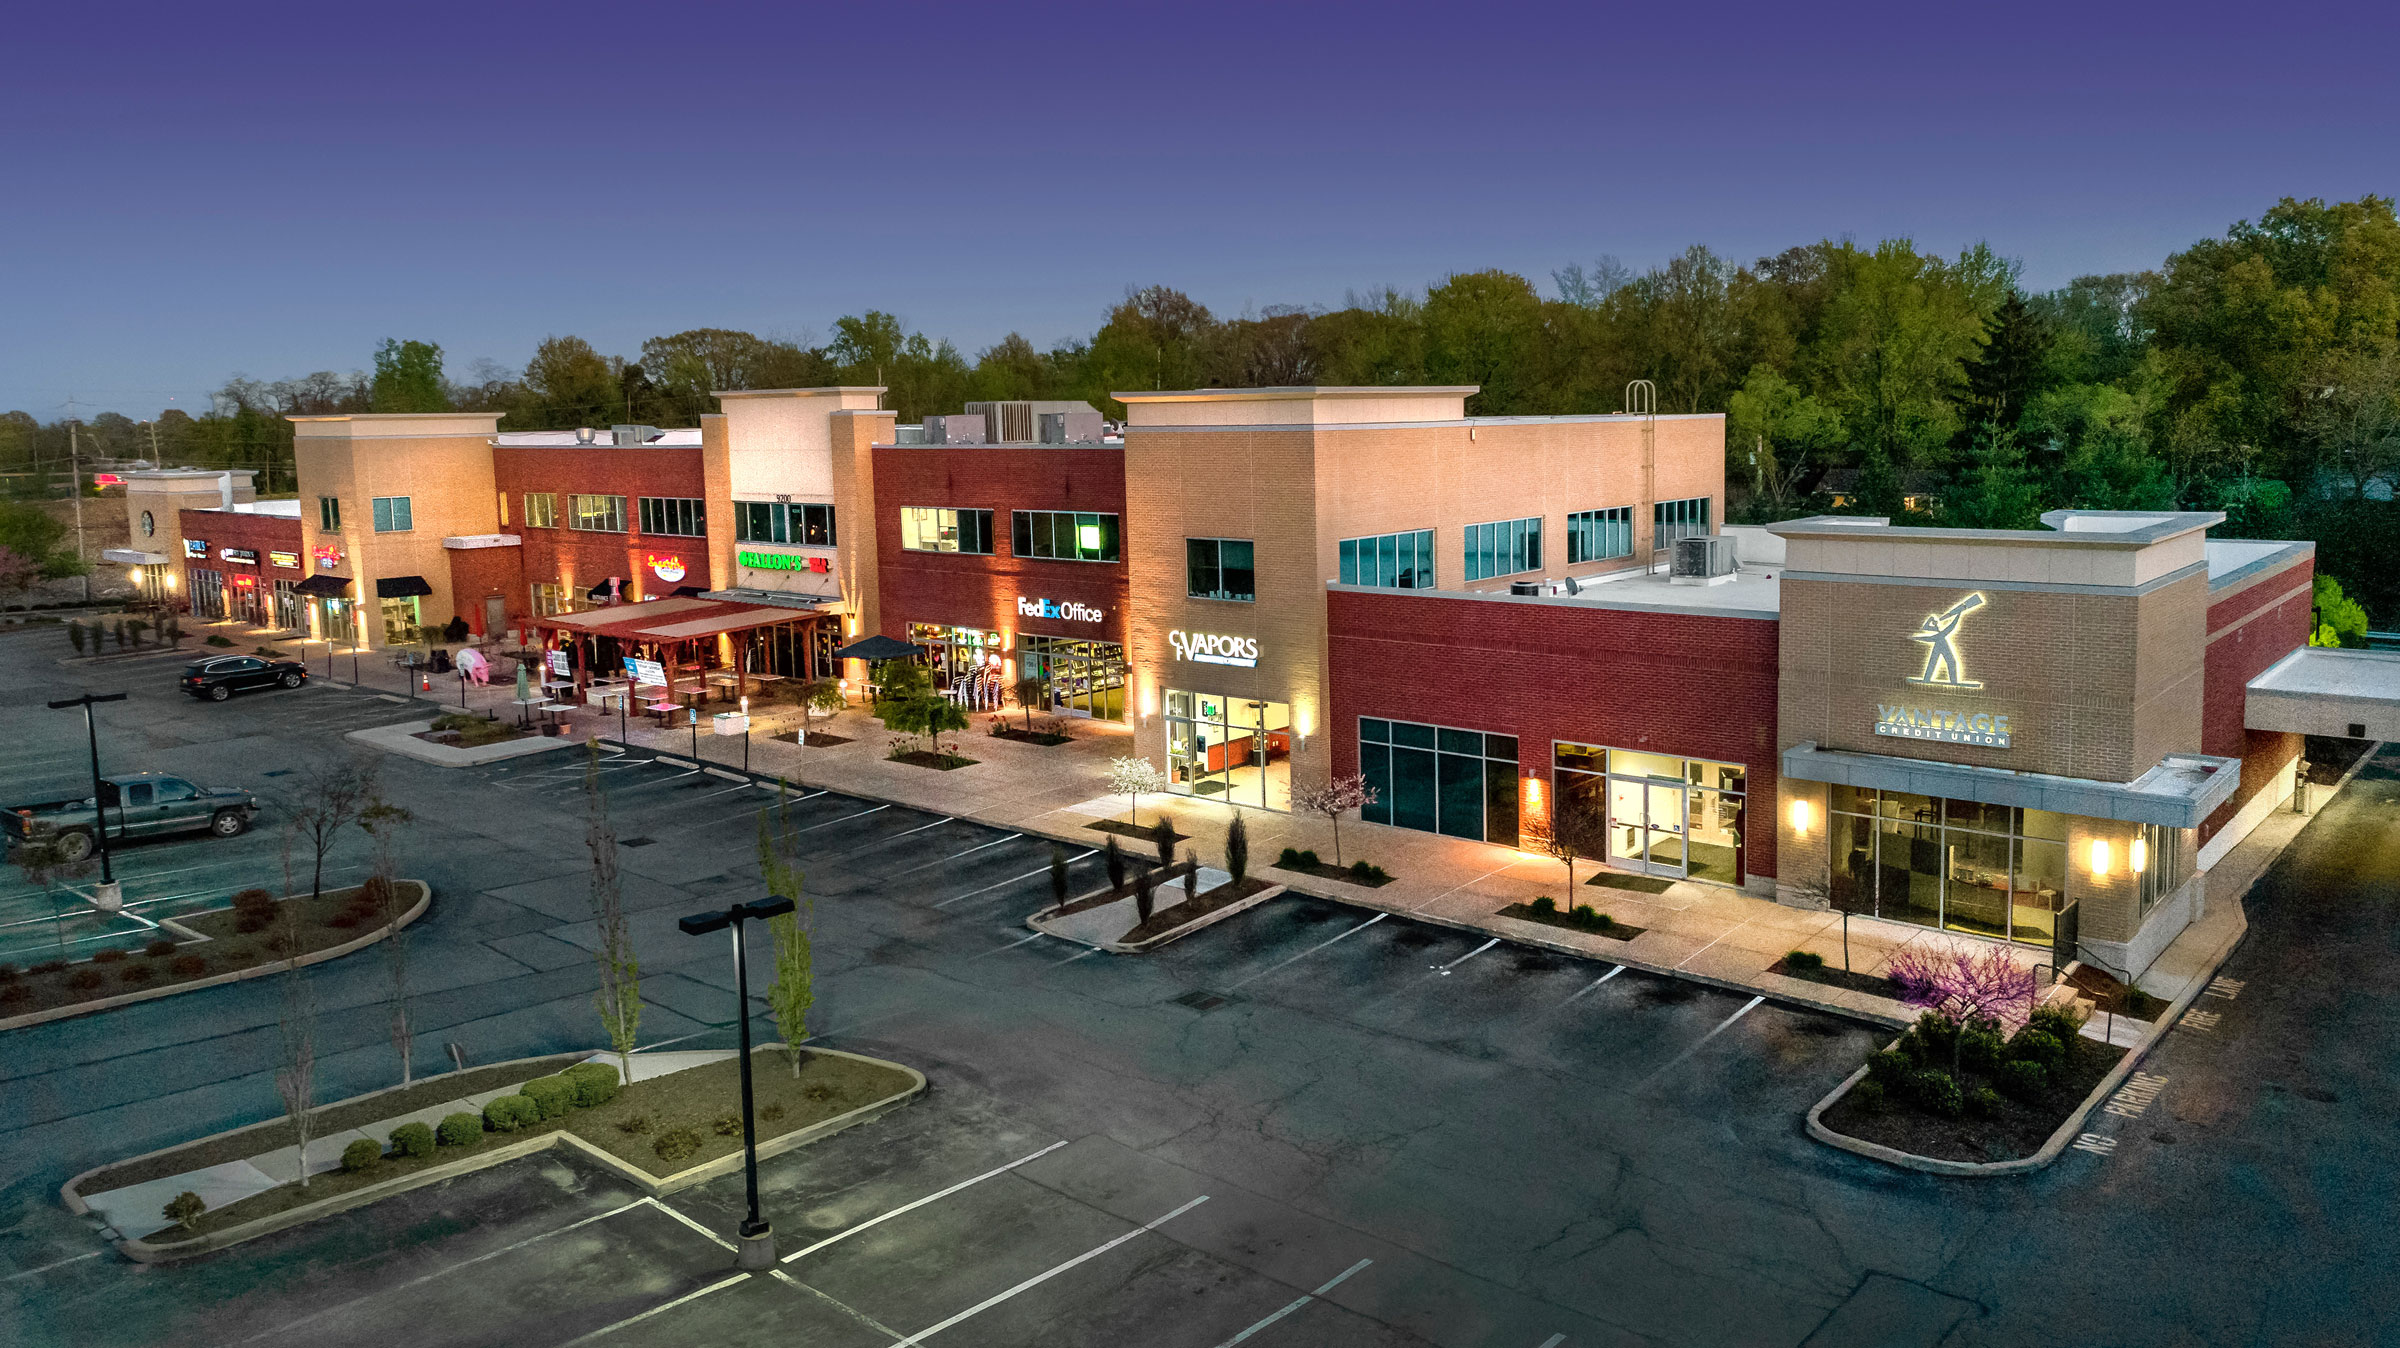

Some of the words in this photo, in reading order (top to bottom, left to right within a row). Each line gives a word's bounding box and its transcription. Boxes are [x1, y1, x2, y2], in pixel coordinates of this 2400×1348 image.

[776, 494, 792, 504] 9200
[1017, 596, 1061, 619] FedEx
[1060, 601, 1103, 623] Office
[1877, 703, 2010, 737] VANTAGE
[1879, 725, 1942, 739] CREDIT
[1951, 732, 2006, 746] UNION
[2072, 1132, 2118, 1156] NO
[2103, 1071, 2169, 1119] PARKING
[2178, 1007, 2222, 1032] FIRE
[2203, 975, 2247, 1000] LANE
